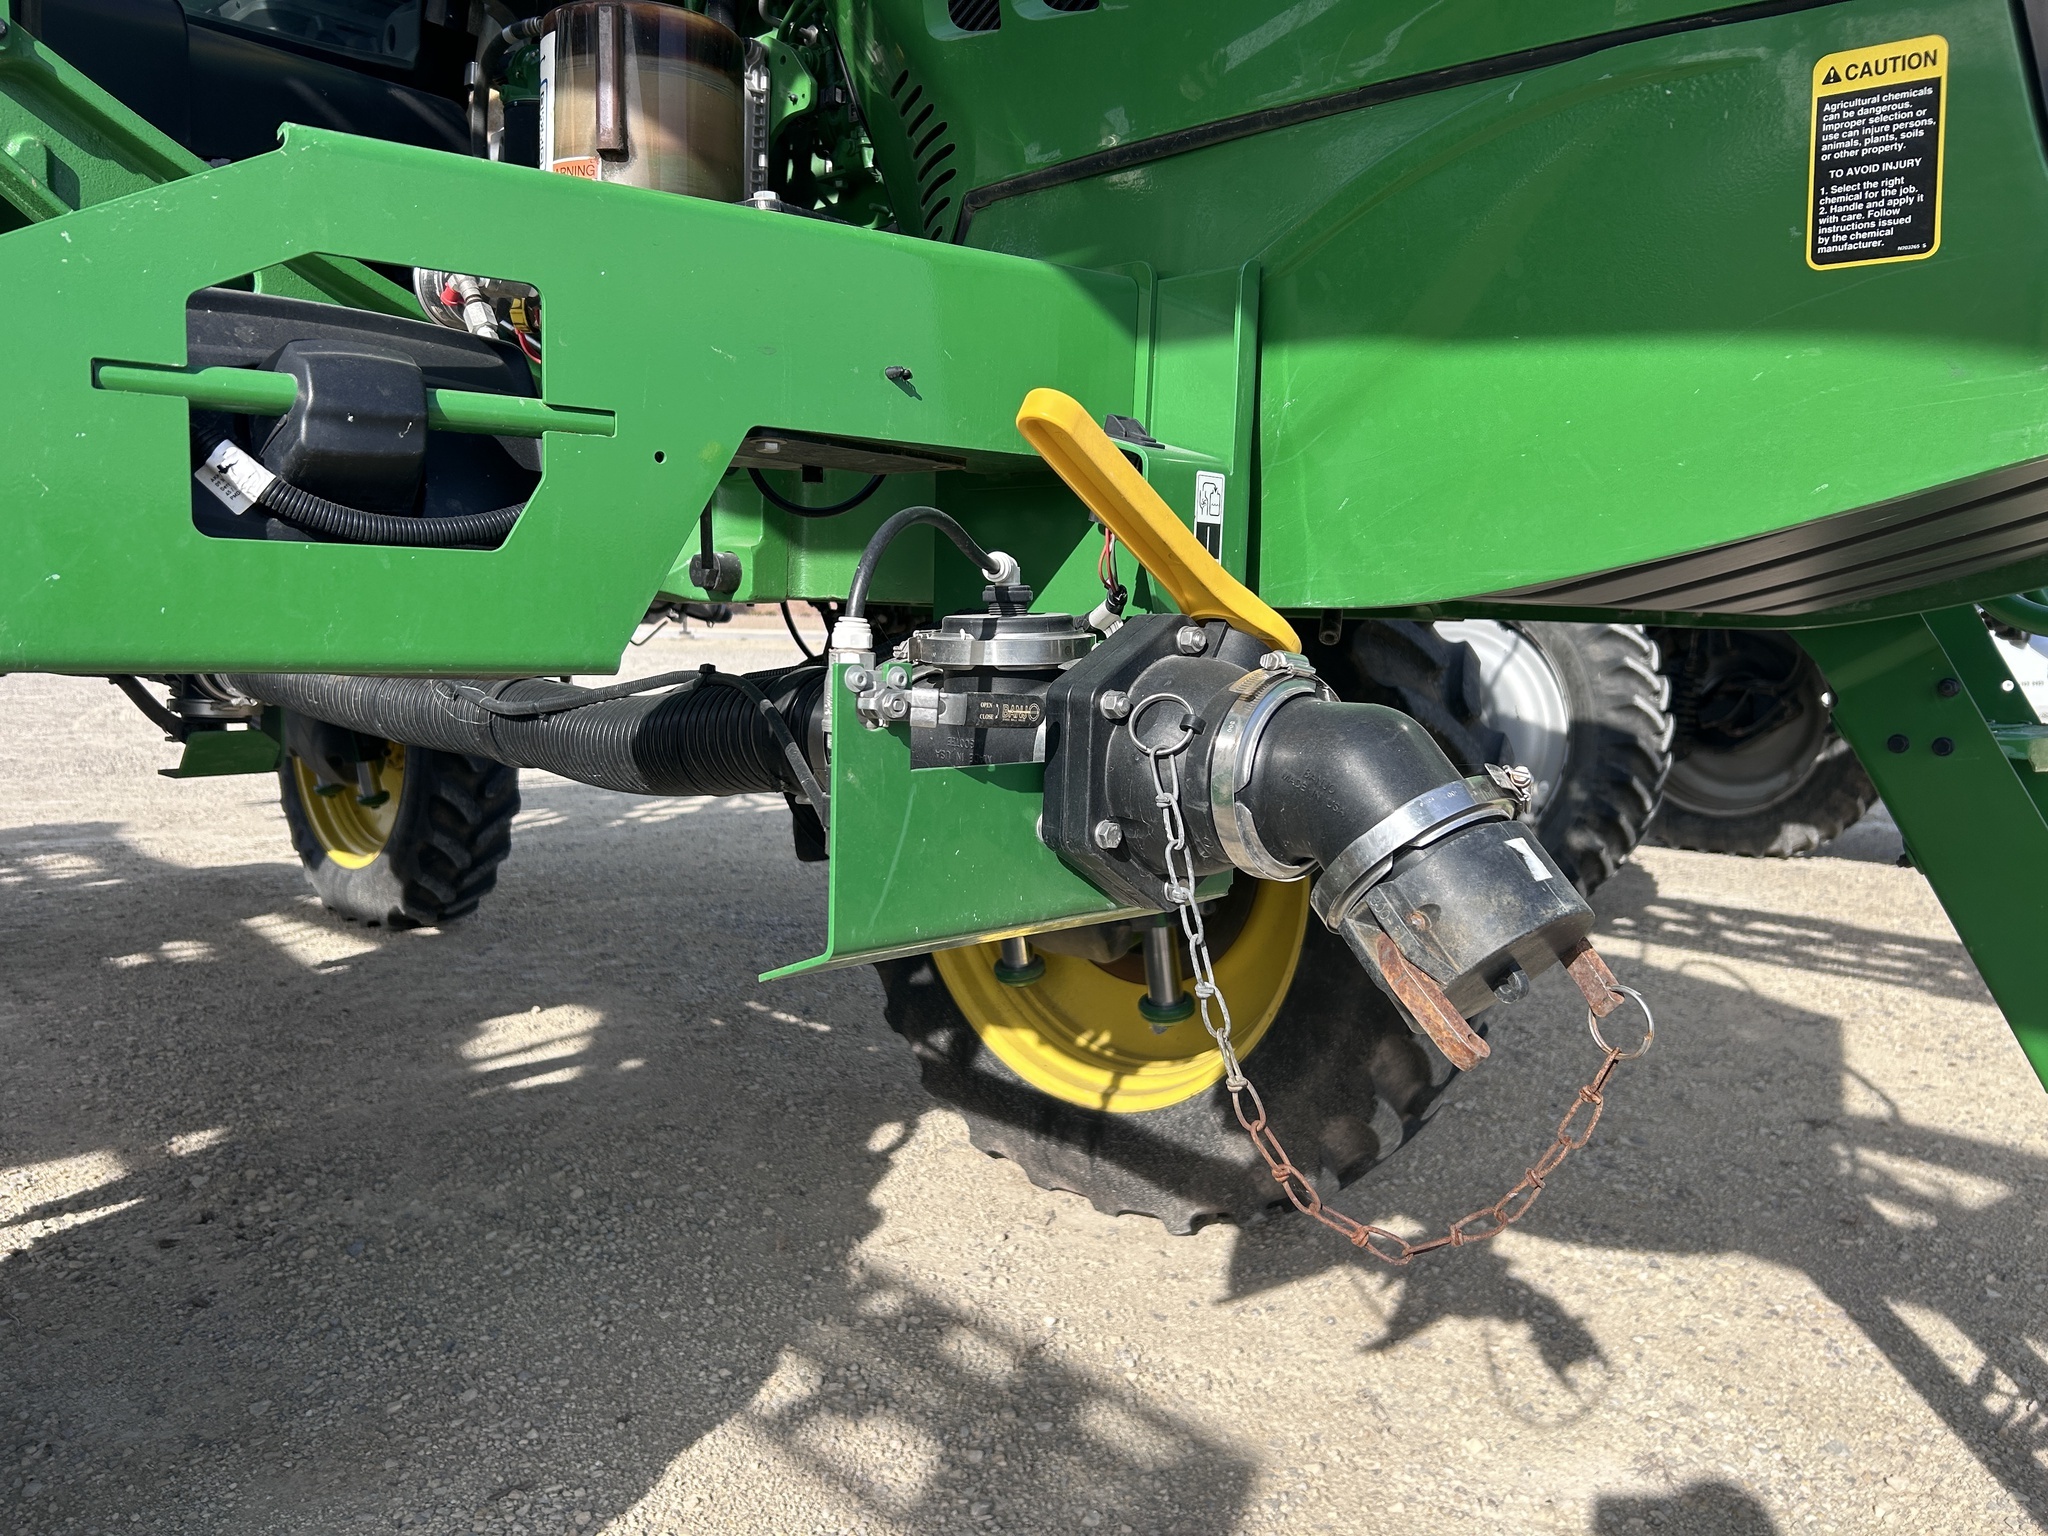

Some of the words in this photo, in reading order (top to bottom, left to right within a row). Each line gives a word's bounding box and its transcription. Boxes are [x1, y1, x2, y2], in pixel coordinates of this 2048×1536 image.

[1845, 49, 1938, 80] CAUTION
[1823, 95, 1880, 112] Agricultural
[1882, 86, 1933, 102] chemicals
[1823, 112, 1840, 121] can
[1843, 110, 1854, 119] be
[1857, 101, 1913, 116] dangerous.
[1822, 118, 1866, 131] Improper
[1869, 112, 1913, 124] selection
[1822, 132, 1839, 141] use
[1842, 129, 1859, 138] can
[1862, 123, 1890, 135] injure
[1893, 118, 1936, 132] persons,
[1821, 139, 1862, 151] animals,
[1864, 133, 1897, 146] plants,
[1900, 129, 1924, 139] soils
[1821, 153, 1832, 161] or
[1834, 148, 1859, 159] other
[1861, 142, 1906, 156] property.
[1829, 169, 1843, 179] TO
[1846, 164, 1879, 176] AVOID
[1882, 157, 1922, 171] INJURY
[1819, 192, 1862, 205] chemical
[1865, 191, 1879, 199] for
[1881, 188, 1897, 197] the
[1899, 185, 1918, 196] job.
[1820, 187, 1828, 195] 1.
[1831, 183, 1861, 194] Select
[1863, 180, 1878, 189] the
[1881, 176, 1904, 188] right
[1819, 207, 1827, 215] 2.
[1830, 203, 1863, 214] Handle
[1866, 198, 1885, 209] and
[1887, 194, 1914, 206] apply
[1917, 193, 1924, 202] it
[1819, 215, 1839, 224] with
[1841, 213, 1865, 222] care.
[1867, 208, 1901, 218] Follow
[1819, 220, 1875, 234] instructions
[1878, 215, 1912, 227] issued
[1818, 236, 1830, 245] by
[1832, 233, 1848, 242] the
[1850, 227, 1893, 240] chemical
[1817, 240, 1884, 254] manufacturer.
[1326, 799, 1347, 817] USA
